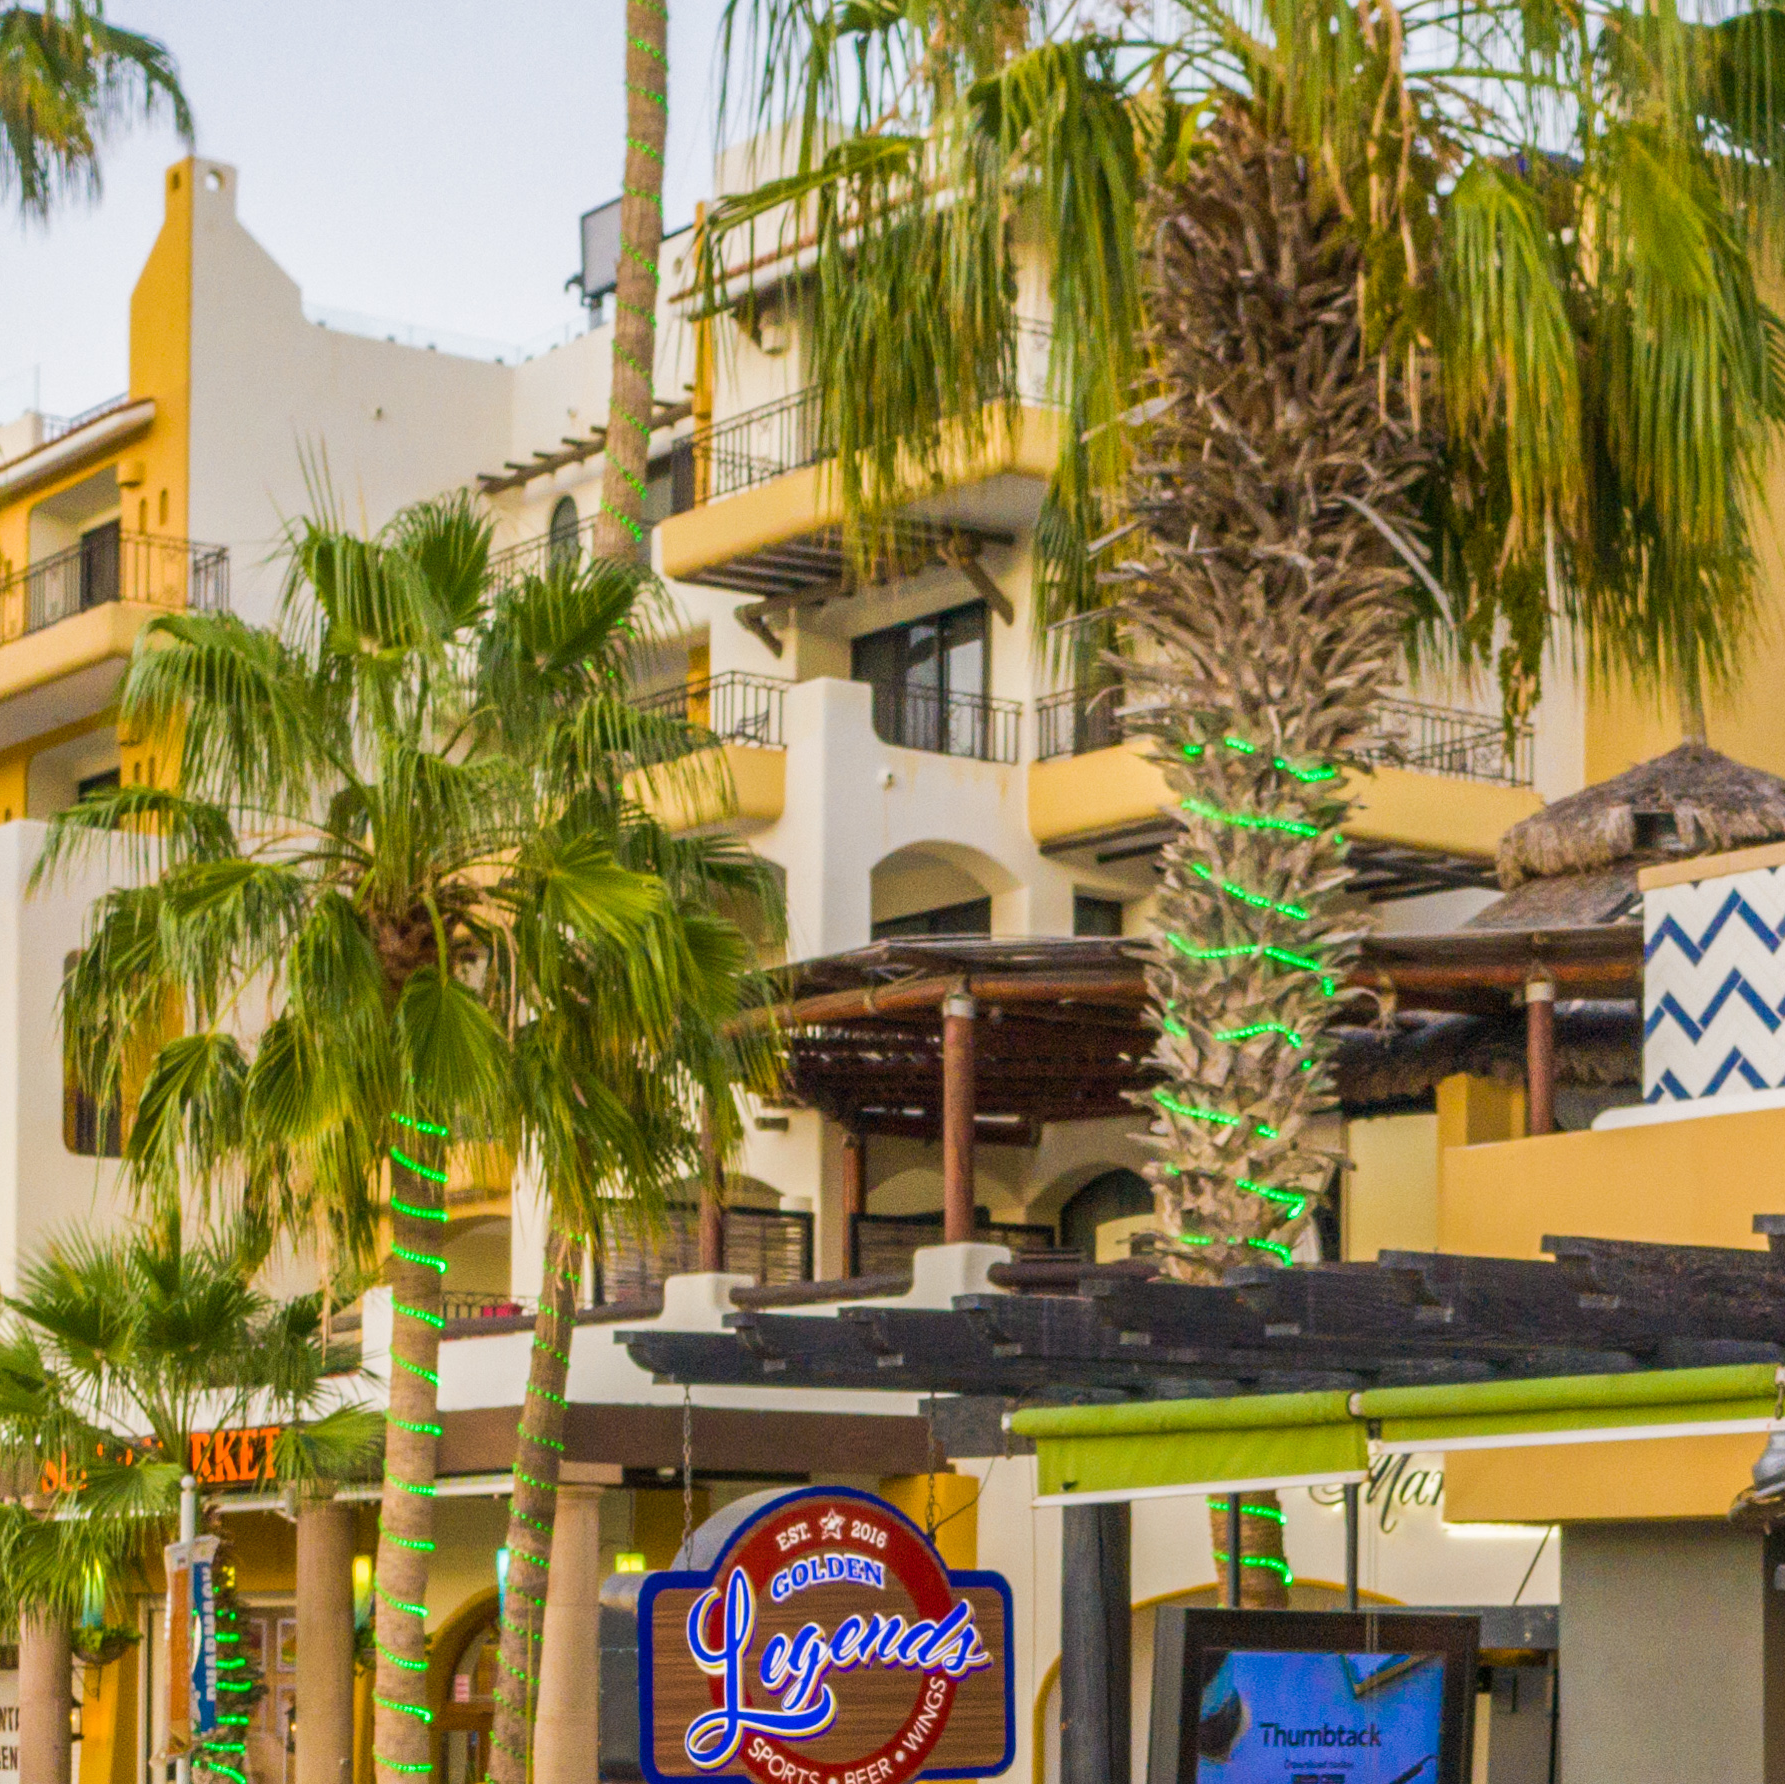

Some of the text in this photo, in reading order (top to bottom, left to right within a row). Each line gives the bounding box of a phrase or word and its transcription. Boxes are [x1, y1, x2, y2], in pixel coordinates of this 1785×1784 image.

[776, 1519, 888, 1551] EST. 2016
[770, 1553, 886, 1602] GOLDEN
[685, 1566, 994, 1774] Legends
[902, 1676, 948, 1752] WINGS
[1260, 1722, 1382, 1748] Thumbtack
